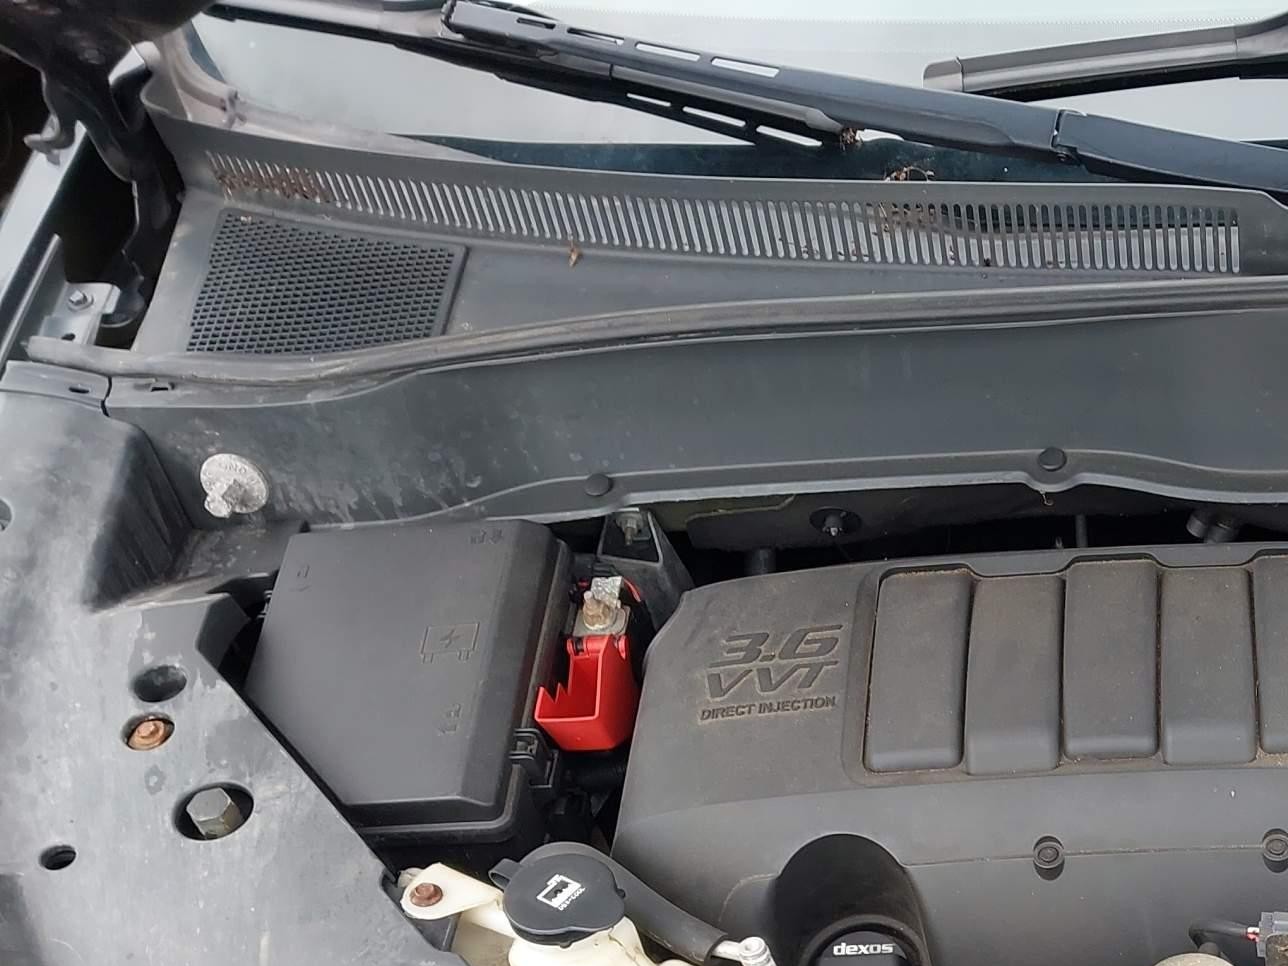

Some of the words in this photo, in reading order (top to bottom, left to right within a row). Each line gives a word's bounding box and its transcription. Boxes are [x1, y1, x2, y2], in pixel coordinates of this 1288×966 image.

[708, 624, 844, 669] 3.6
[707, 660, 839, 699] VVT
[701, 703, 756, 721] DIRECT
[758, 695, 837, 714] INJECTION
[833, 942, 896, 956] dexos
